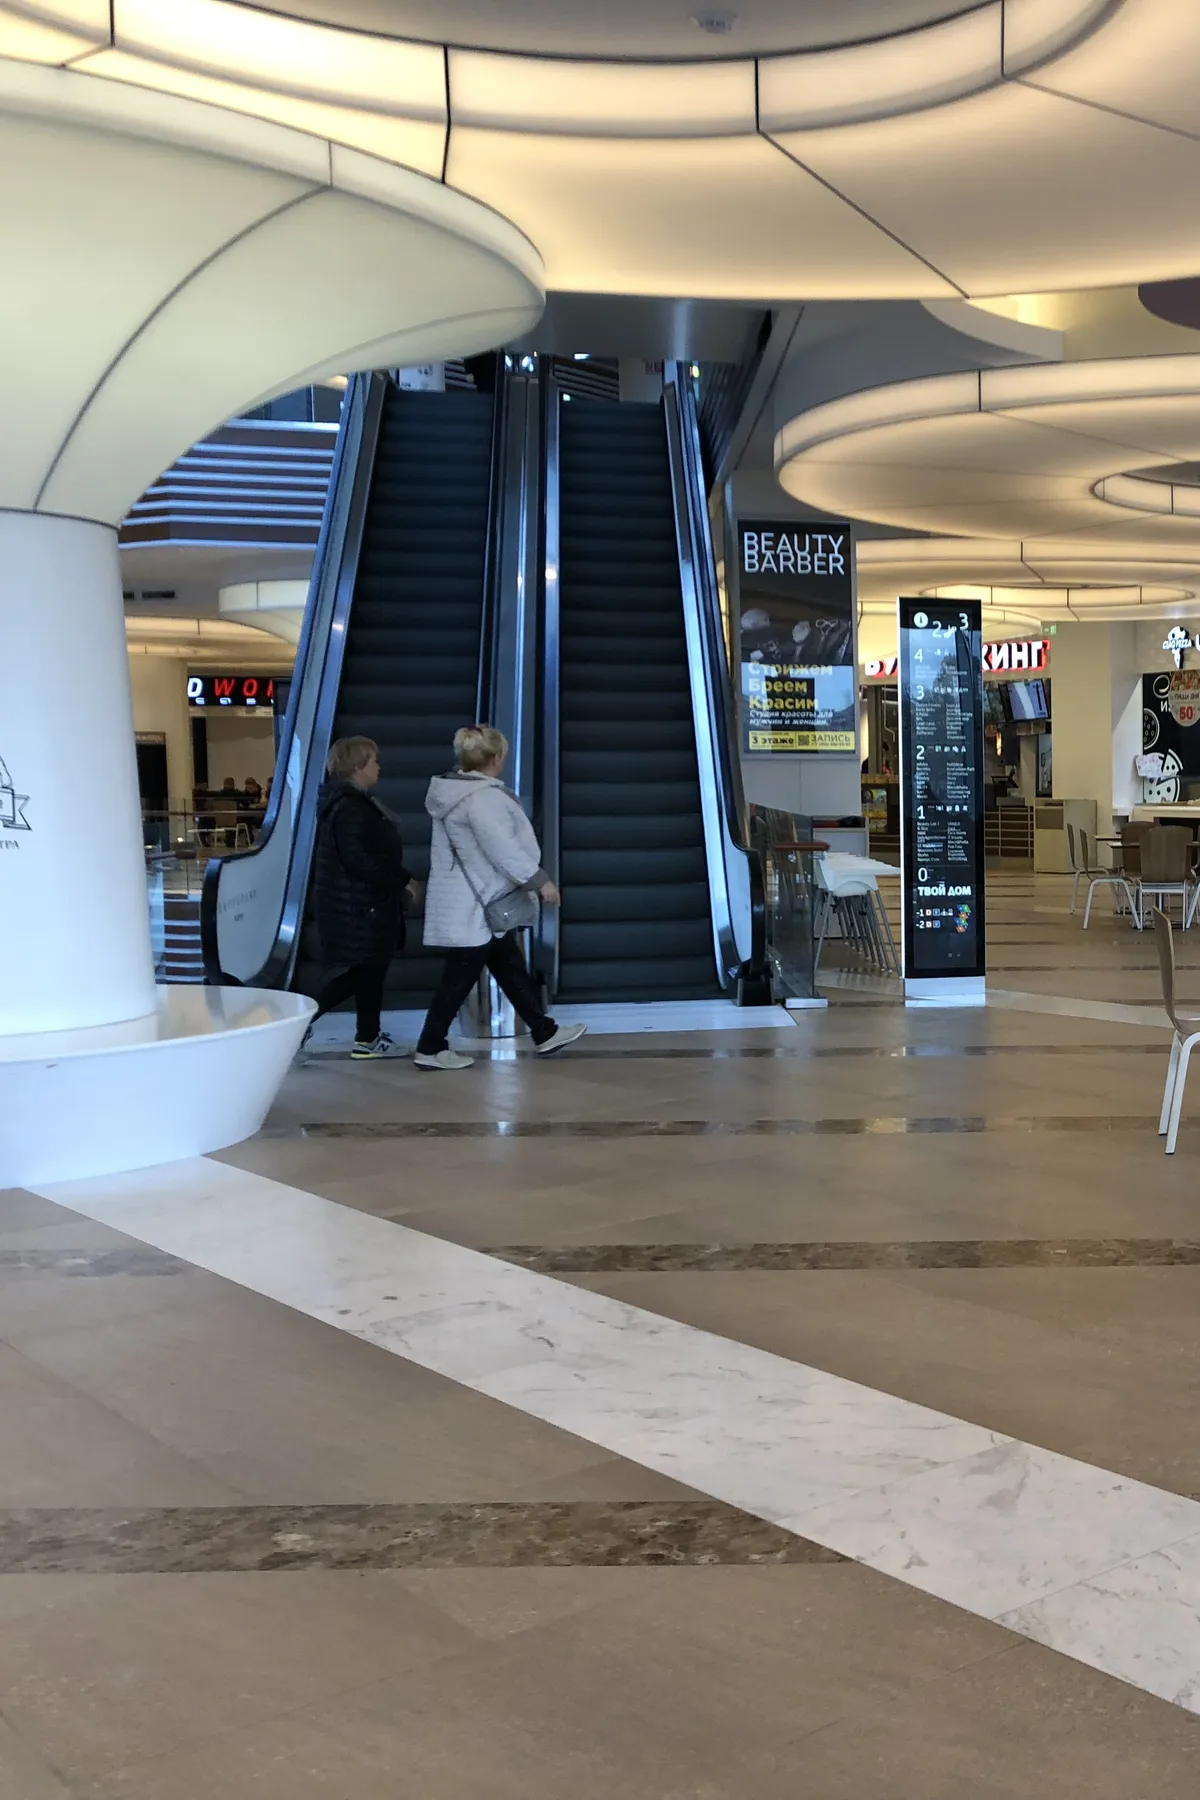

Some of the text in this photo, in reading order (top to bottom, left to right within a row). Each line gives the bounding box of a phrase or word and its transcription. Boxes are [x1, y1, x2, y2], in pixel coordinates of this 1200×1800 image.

[743, 532, 844, 557] BEAUTY
[744, 551, 845, 575] BARBER
[913, 648, 923, 663] 4
[749, 678, 808, 694] Бреем
[916, 685, 925, 700] 3
[749, 695, 819, 711] Красим
[781, 710, 817, 718] красоты
[761, 736, 795, 745] этаже
[811, 734, 851, 742] ЗАПИСЬ
[916, 745, 926, 760] 2
[917, 805, 926, 820] 1
[918, 867, 928, 882] 0
[917, 883, 972, 896] ТВОЙ ДОМ
